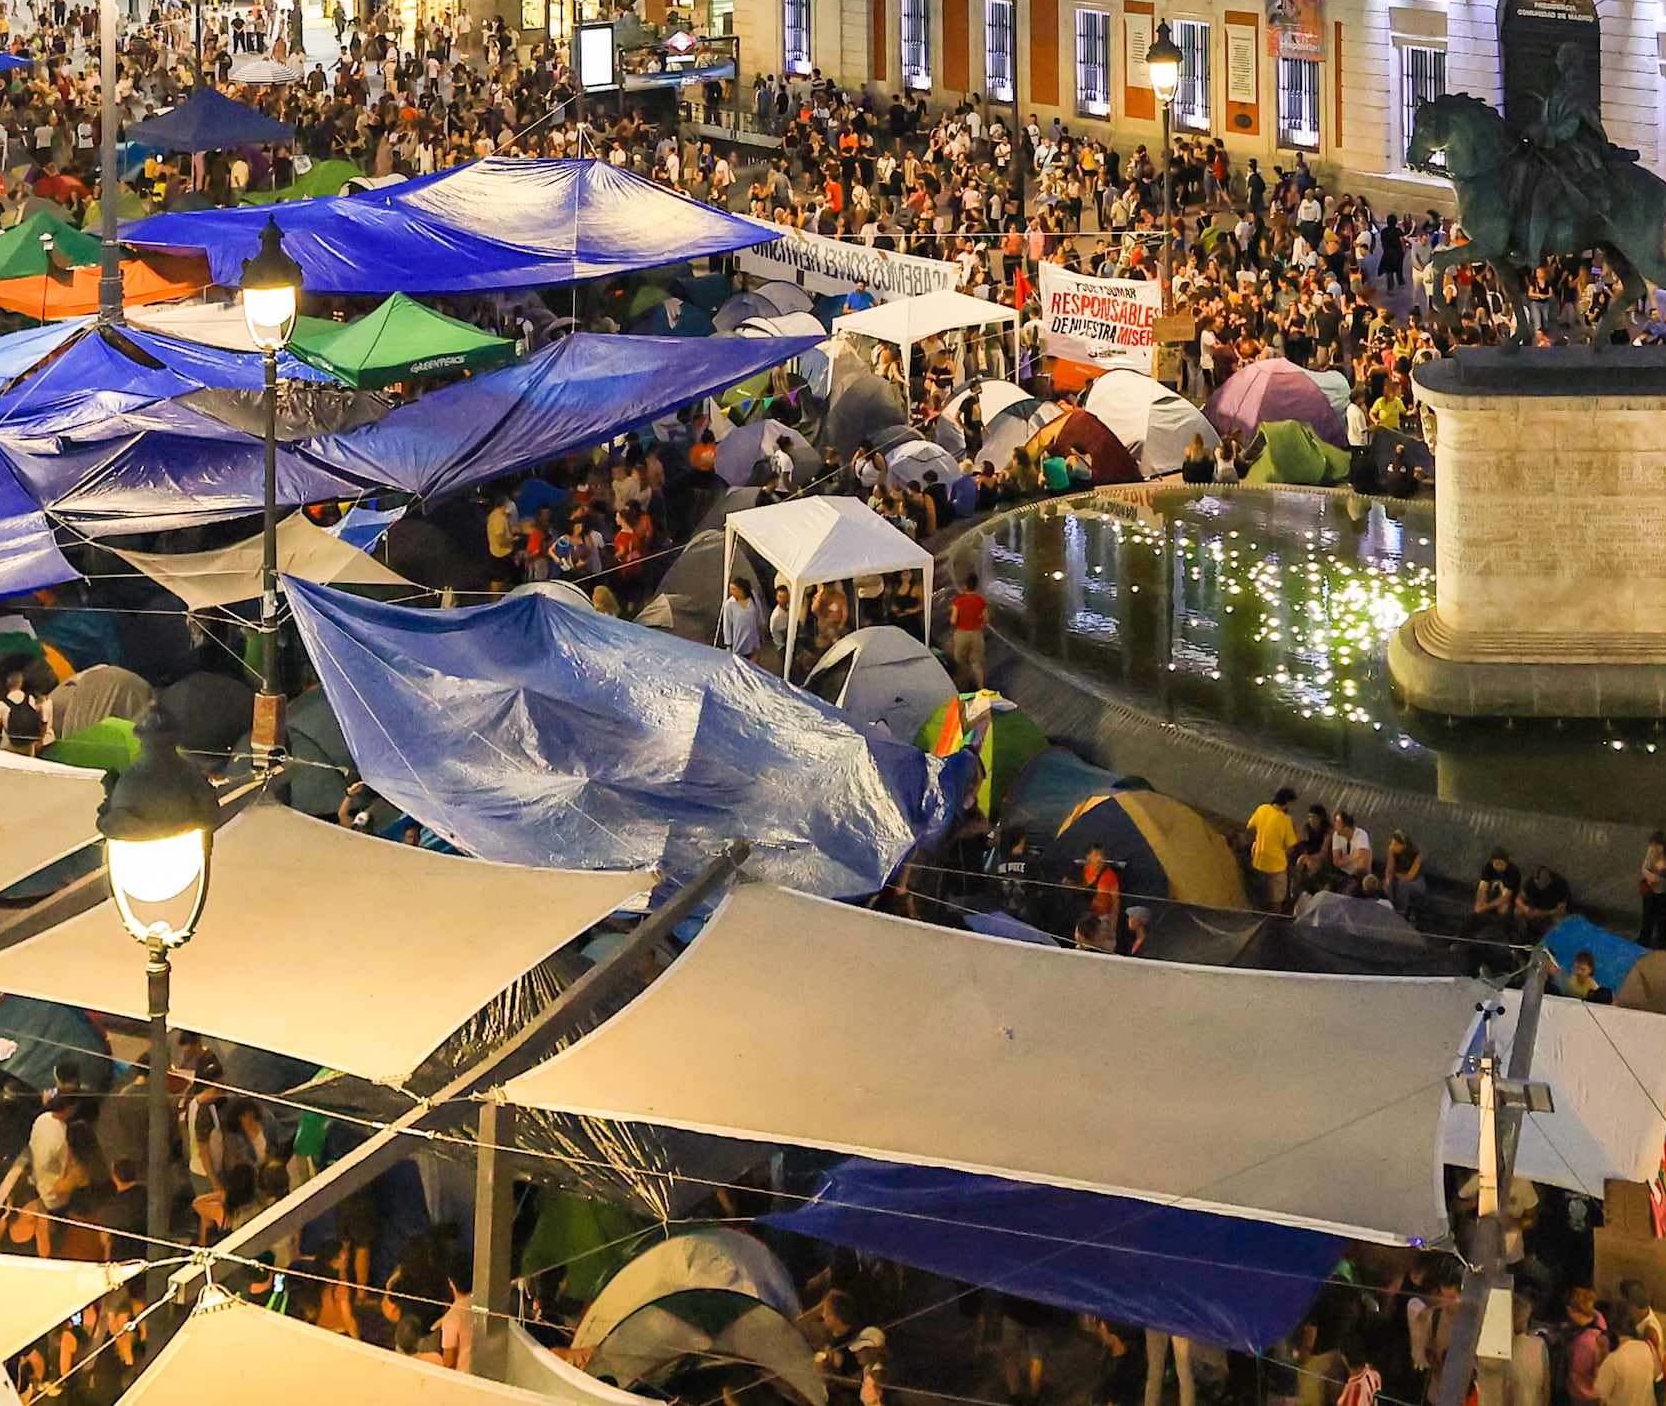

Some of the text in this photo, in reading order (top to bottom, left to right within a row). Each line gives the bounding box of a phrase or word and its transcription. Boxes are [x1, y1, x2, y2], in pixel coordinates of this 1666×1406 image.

[1517, 8, 1594, 23] COMUNIDAD DE MADRID
[1051, 292, 1161, 329] RESPONSABLES
[1051, 316, 1155, 347] DE NUESTRA MISER
[410, 354, 467, 374] GREENPEACE
